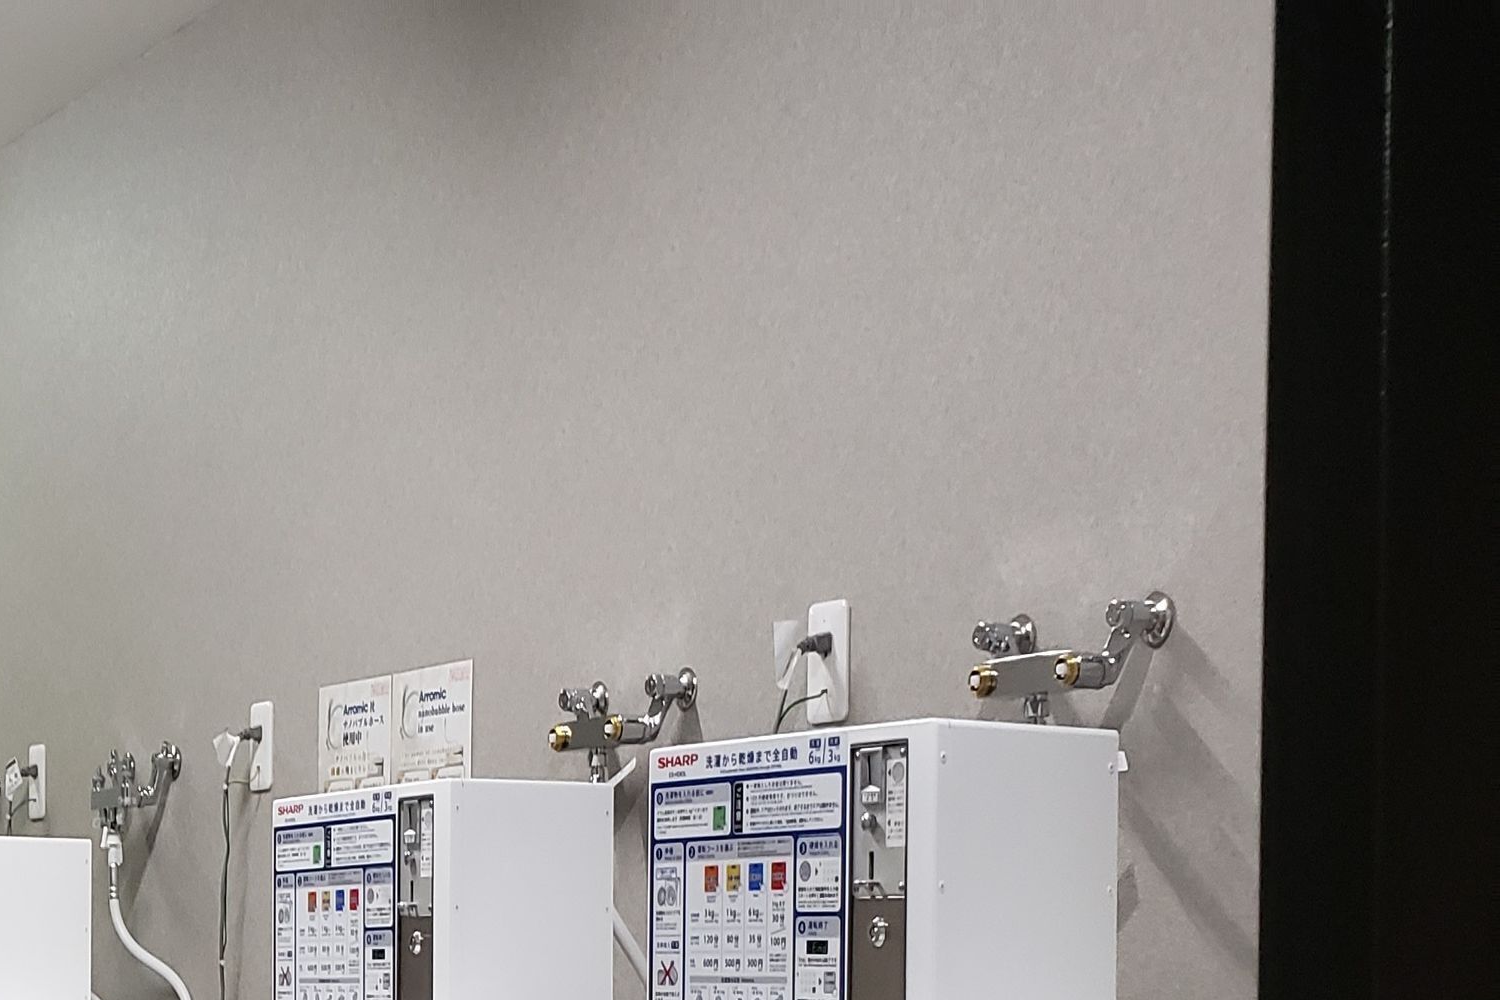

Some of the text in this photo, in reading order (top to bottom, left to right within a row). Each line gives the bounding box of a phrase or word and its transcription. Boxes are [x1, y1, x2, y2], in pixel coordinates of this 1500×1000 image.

[419, 687, 446, 703] Arromic
[343, 701, 368, 716] Arromic
[418, 702, 465, 718] nanobubble hose
[418, 724, 434, 734] in use
[343, 730, 362, 747] 使用中
[657, 753, 698, 769] SHARP
[706, 746, 798, 769] 洗濯から乾燥まで全自動
[278, 804, 303, 816] SHARP
